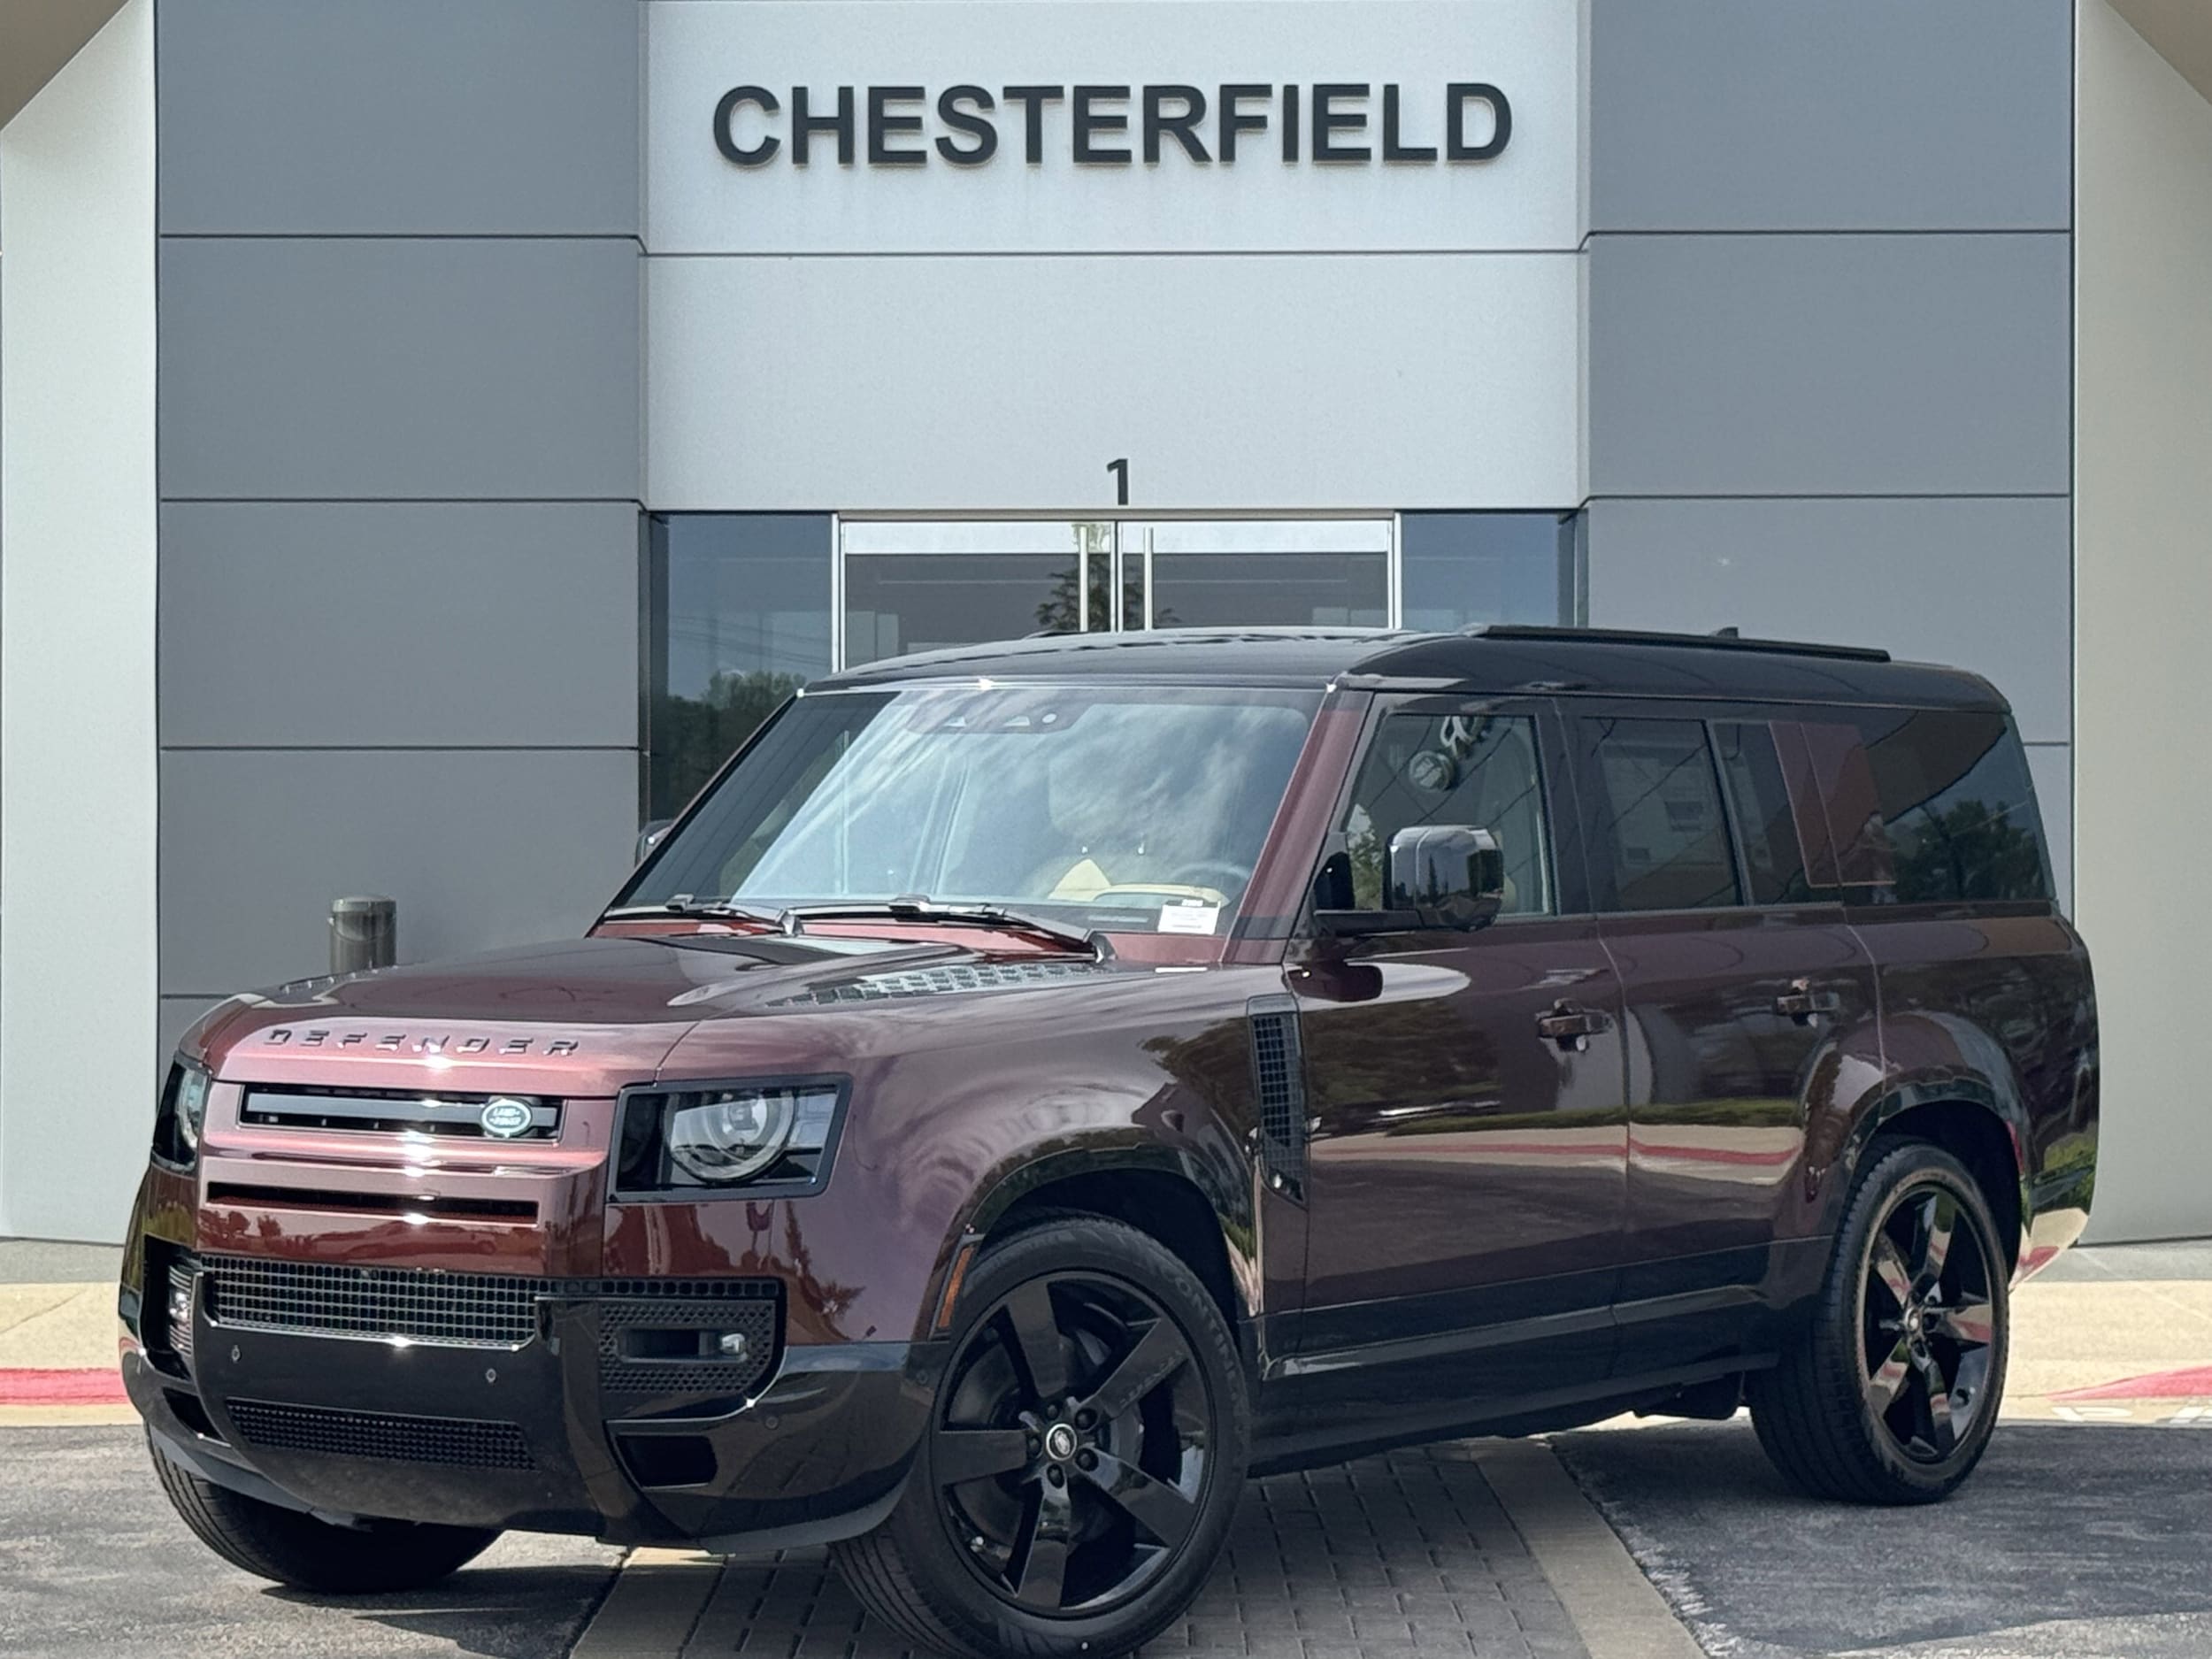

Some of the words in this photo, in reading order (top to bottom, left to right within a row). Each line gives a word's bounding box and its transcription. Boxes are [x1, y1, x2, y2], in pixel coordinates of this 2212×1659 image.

[712, 83, 1513, 166] CHESTERFIELD
[1105, 457, 1130, 506] 1
[263, 1028, 580, 1056] DEFENDER
